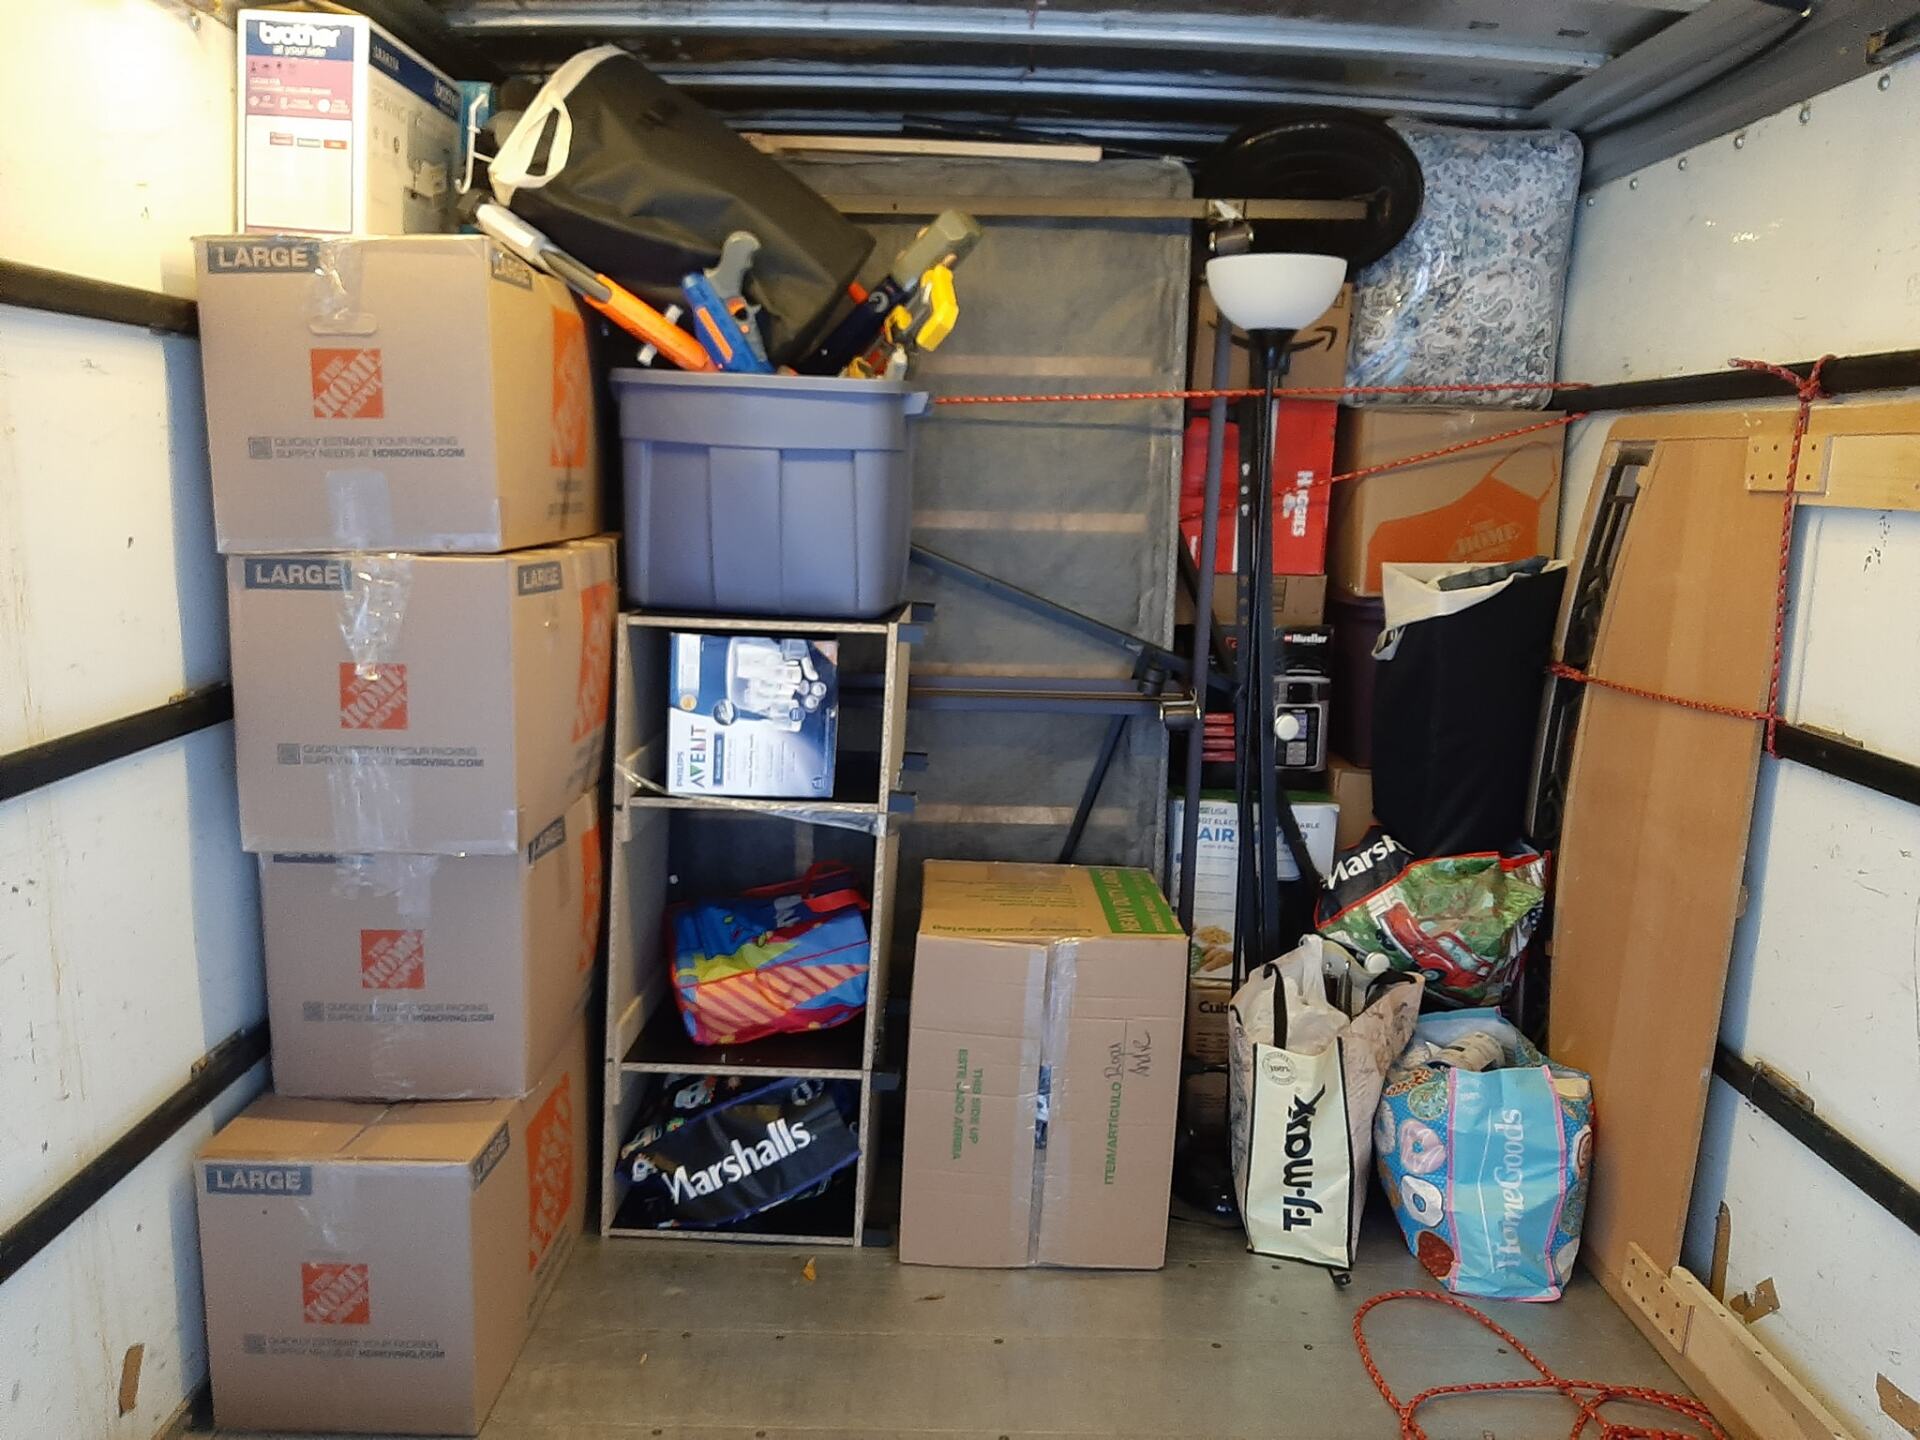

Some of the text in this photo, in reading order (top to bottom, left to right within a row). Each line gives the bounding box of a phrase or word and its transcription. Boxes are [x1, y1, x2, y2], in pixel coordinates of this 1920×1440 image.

[258, 21, 341, 48] brother
[218, 245, 309, 268] LARGE
[255, 563, 340, 585] LARGE
[1293, 633, 1328, 643] Mueller
[690, 724, 707, 788] AVENT
[1199, 827, 1235, 843] AIR
[215, 1169, 302, 1190] LARGE
